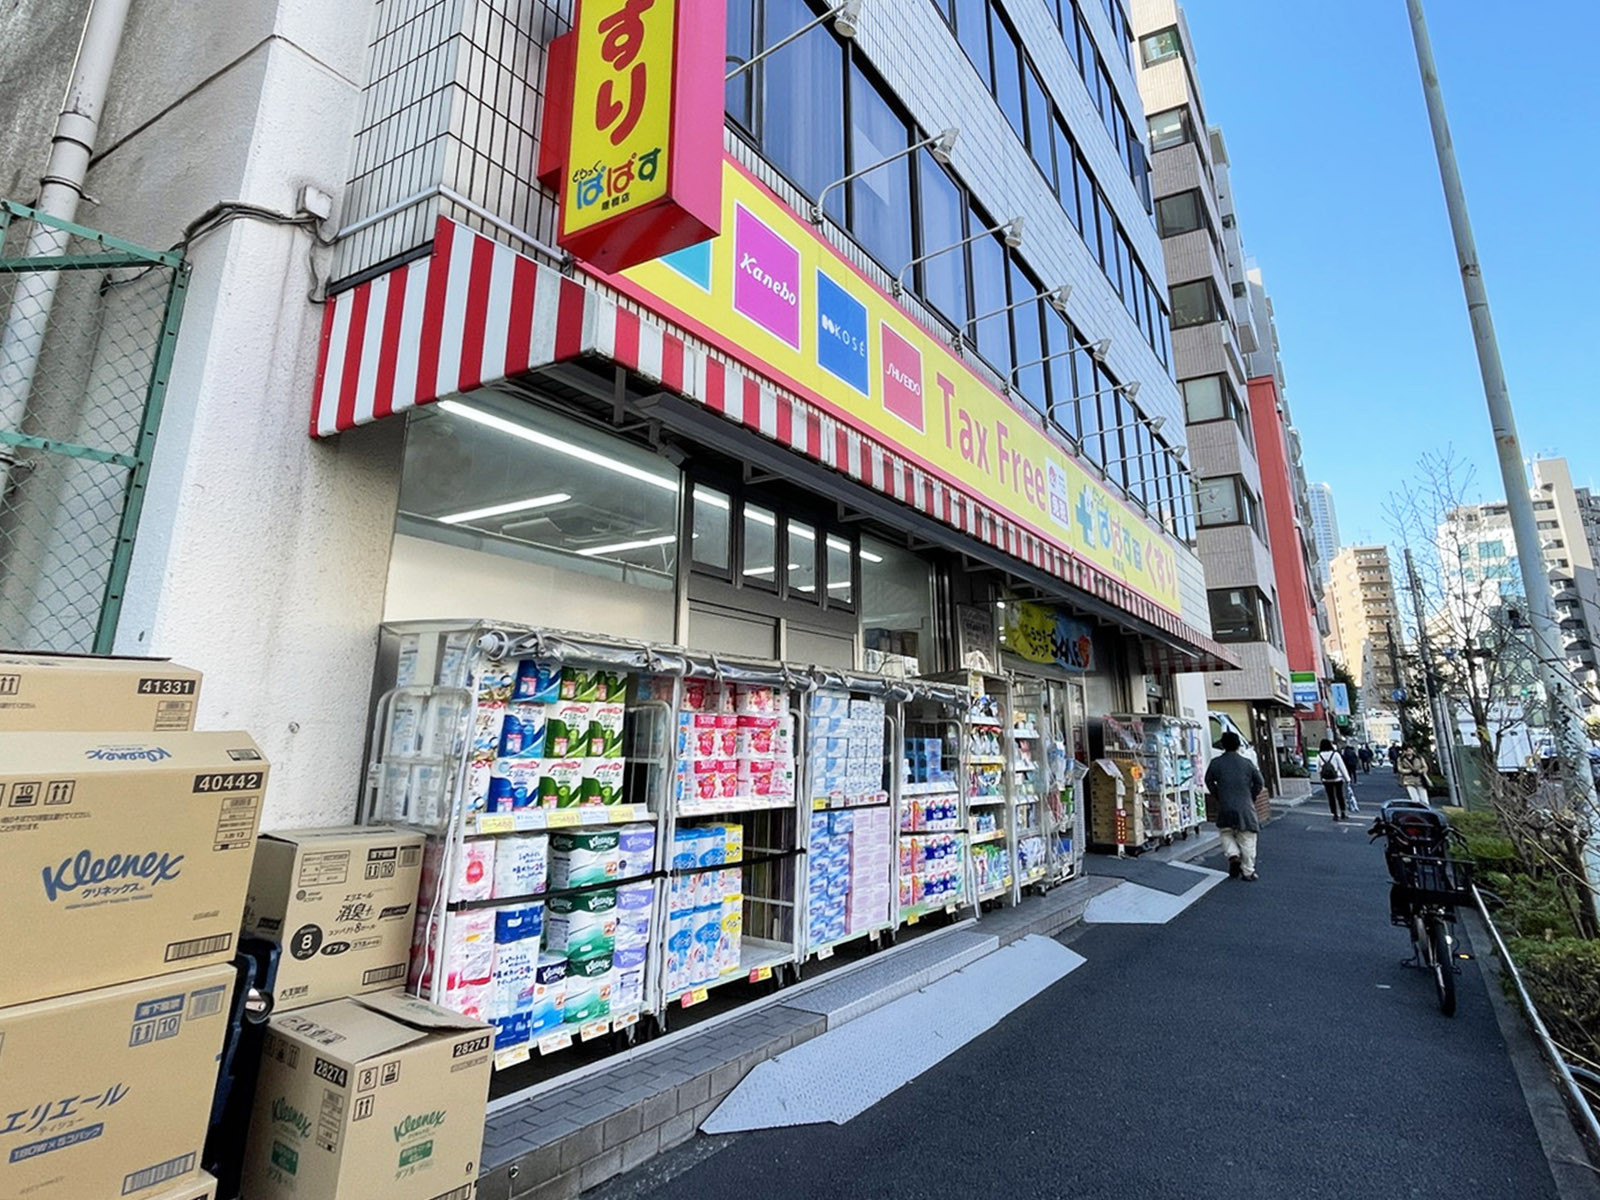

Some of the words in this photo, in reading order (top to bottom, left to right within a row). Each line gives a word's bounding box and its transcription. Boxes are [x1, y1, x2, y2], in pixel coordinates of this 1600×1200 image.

[740, 252, 797, 307] Kanebo
[886, 362, 921, 396] SHISEIDO
[937, 371, 991, 476] Tax
[996, 420, 1047, 513] Free
[142, 680, 191, 693] 41331
[20, 785, 34, 796] 10
[199, 773, 258, 791] 40442
[42, 849, 185, 902] Kleenex
[82, 882, 140, 899] クリネックス
[301, 934, 313, 949] 8
[161, 1017, 177, 1032] 10
[455, 1037, 488, 1056] 28274
[315, 1059, 345, 1086] 28274
[363, 1071, 372, 1085] 8
[0, 1082, 131, 1135] エリエール
[393, 1110, 447, 1142] Kleenex
